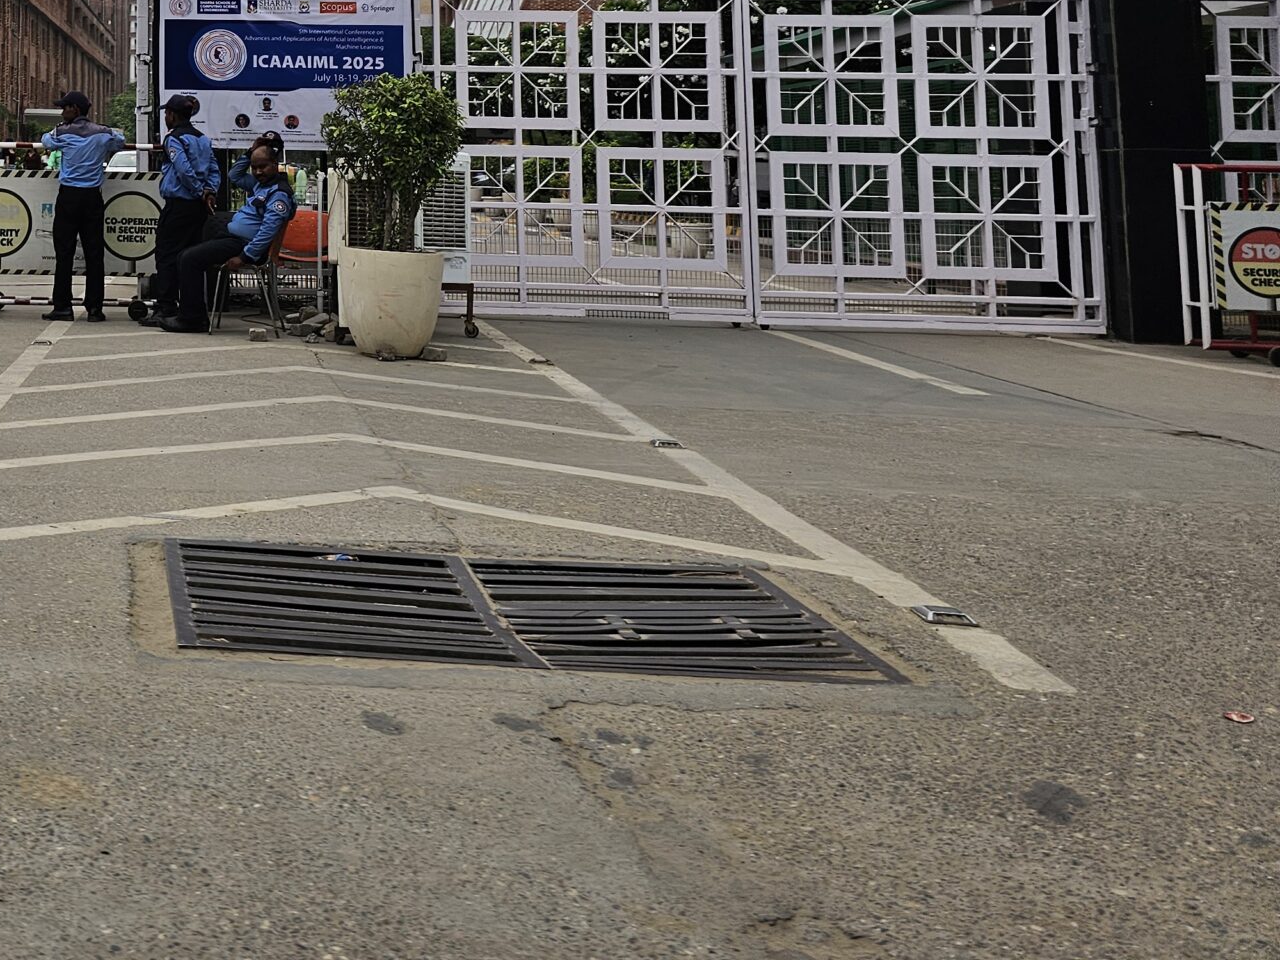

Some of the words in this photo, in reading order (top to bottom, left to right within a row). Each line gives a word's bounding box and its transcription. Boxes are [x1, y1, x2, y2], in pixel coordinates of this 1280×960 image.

[321, 3, 353, 12] Scopus
[370, 5, 395, 13] Springer
[253, 54, 338, 69] ICAAAIML
[342, 56, 384, 70] 2025
[313, 73, 331, 84] July
[105, 217, 159, 226] CO-OPERATE
[116, 234, 146, 243] CHECK
